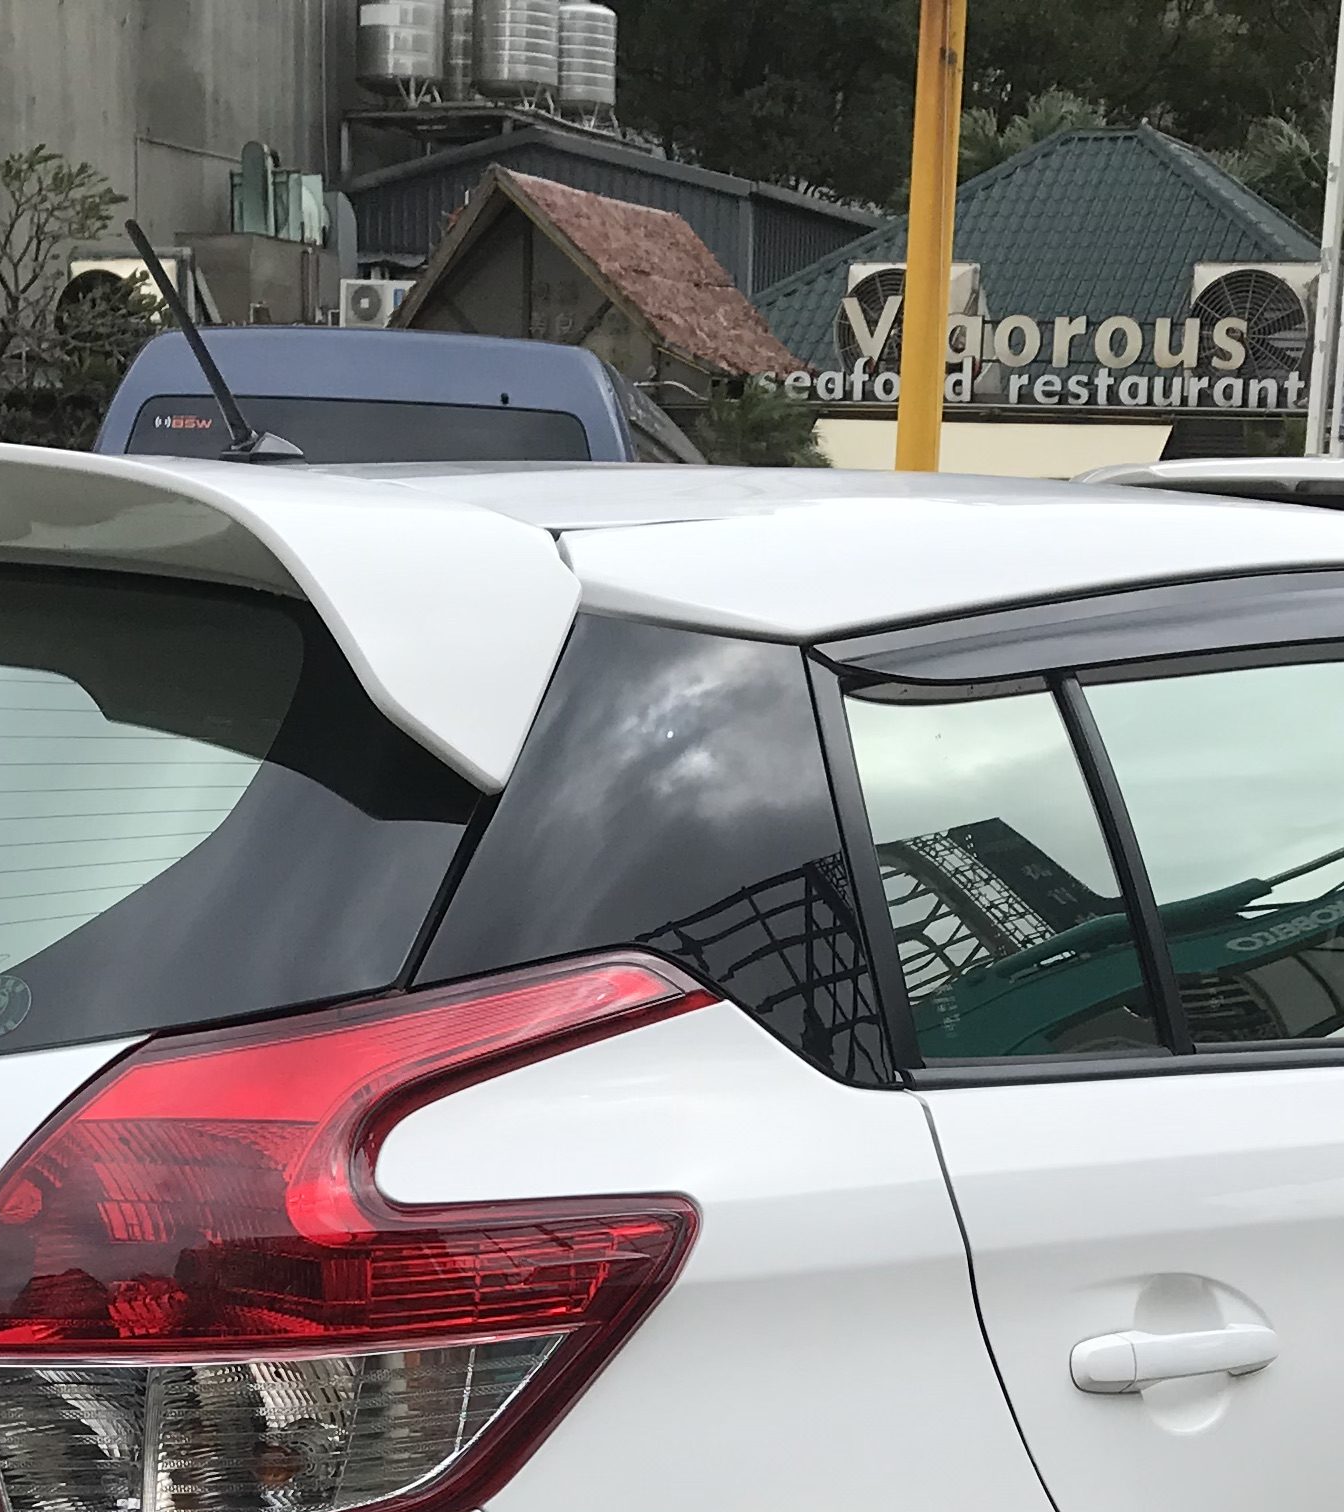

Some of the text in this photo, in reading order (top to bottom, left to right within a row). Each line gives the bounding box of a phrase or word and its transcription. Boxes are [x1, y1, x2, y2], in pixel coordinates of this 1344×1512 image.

[842, 295, 1249, 371] Vgorous
[758, 355, 1307, 409] seafod restaurant
